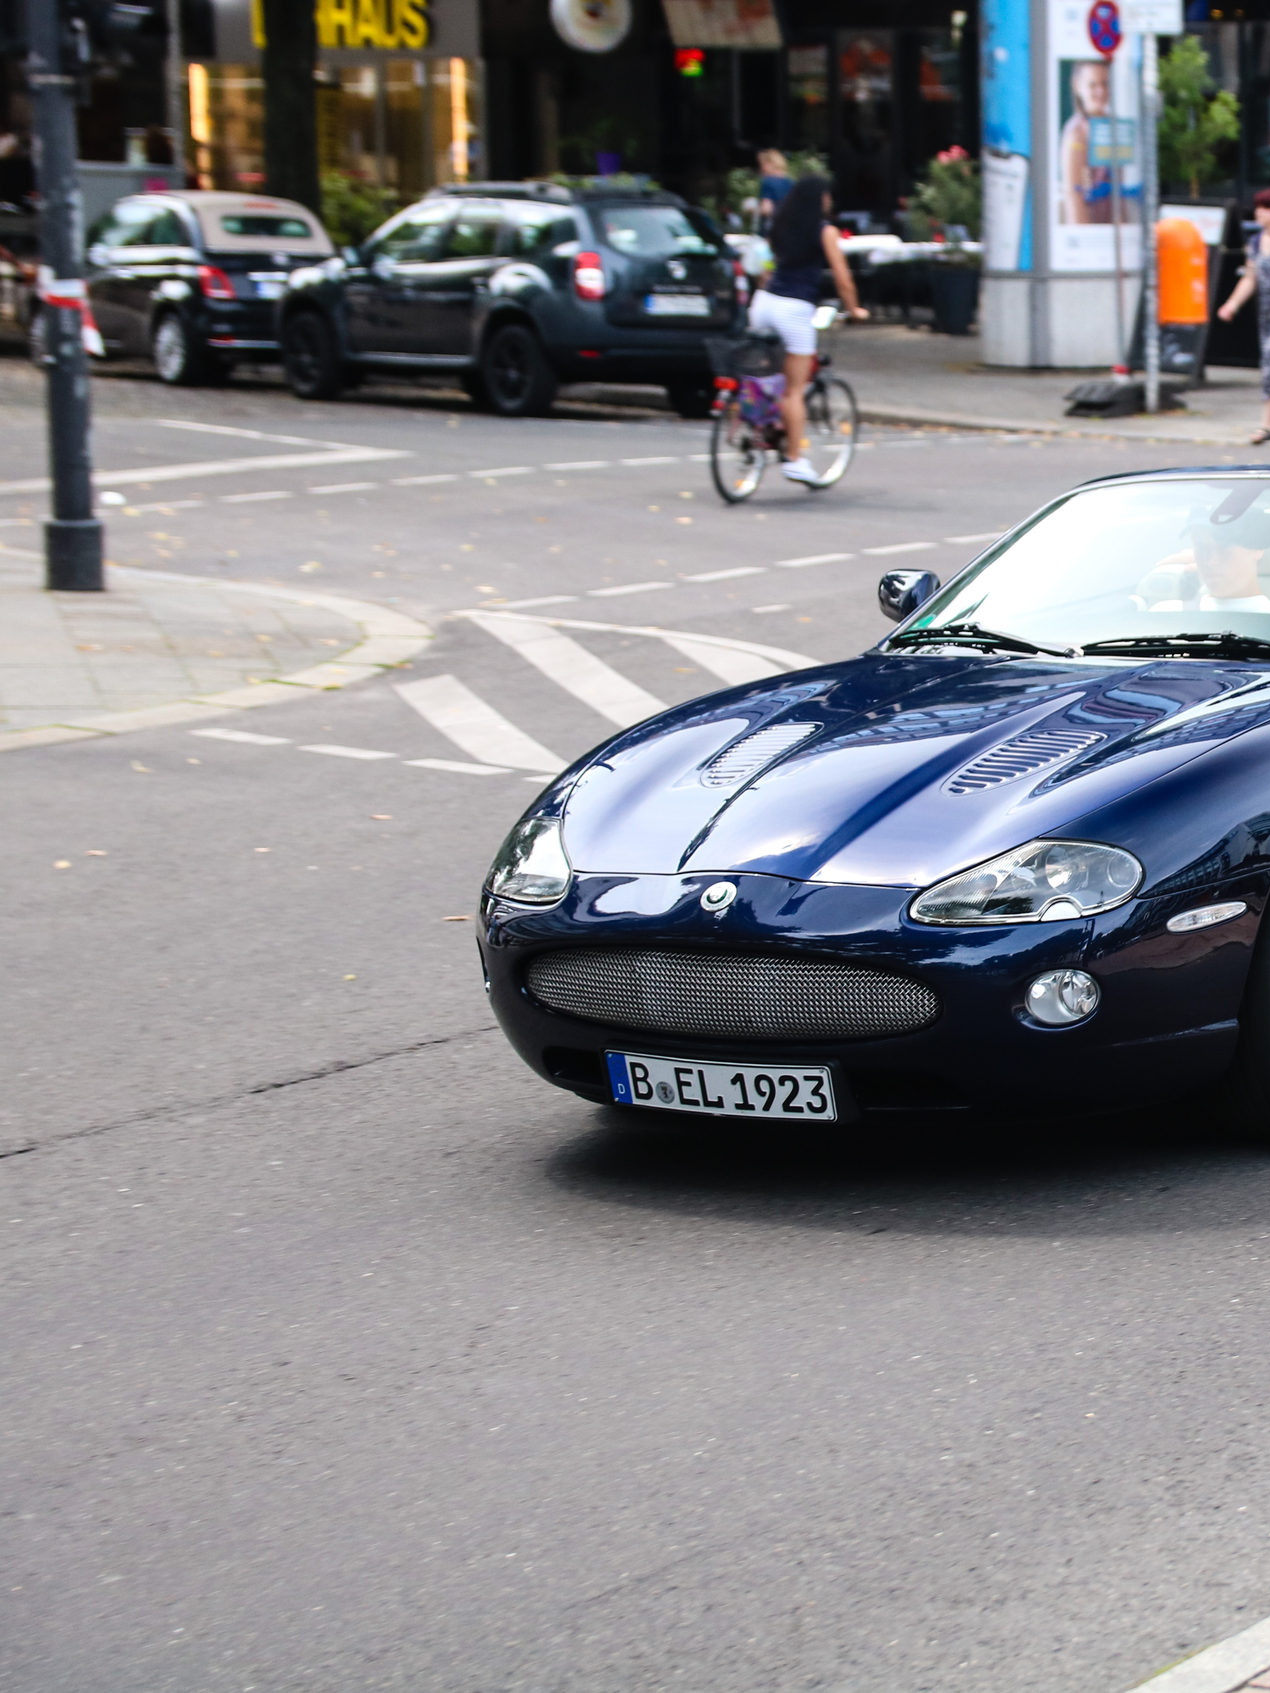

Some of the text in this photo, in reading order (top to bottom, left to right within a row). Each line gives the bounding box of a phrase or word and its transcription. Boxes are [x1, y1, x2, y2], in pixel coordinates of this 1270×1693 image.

[617, 1083, 626, 1094] D
[629, 1061, 829, 1114] B EL 1923
